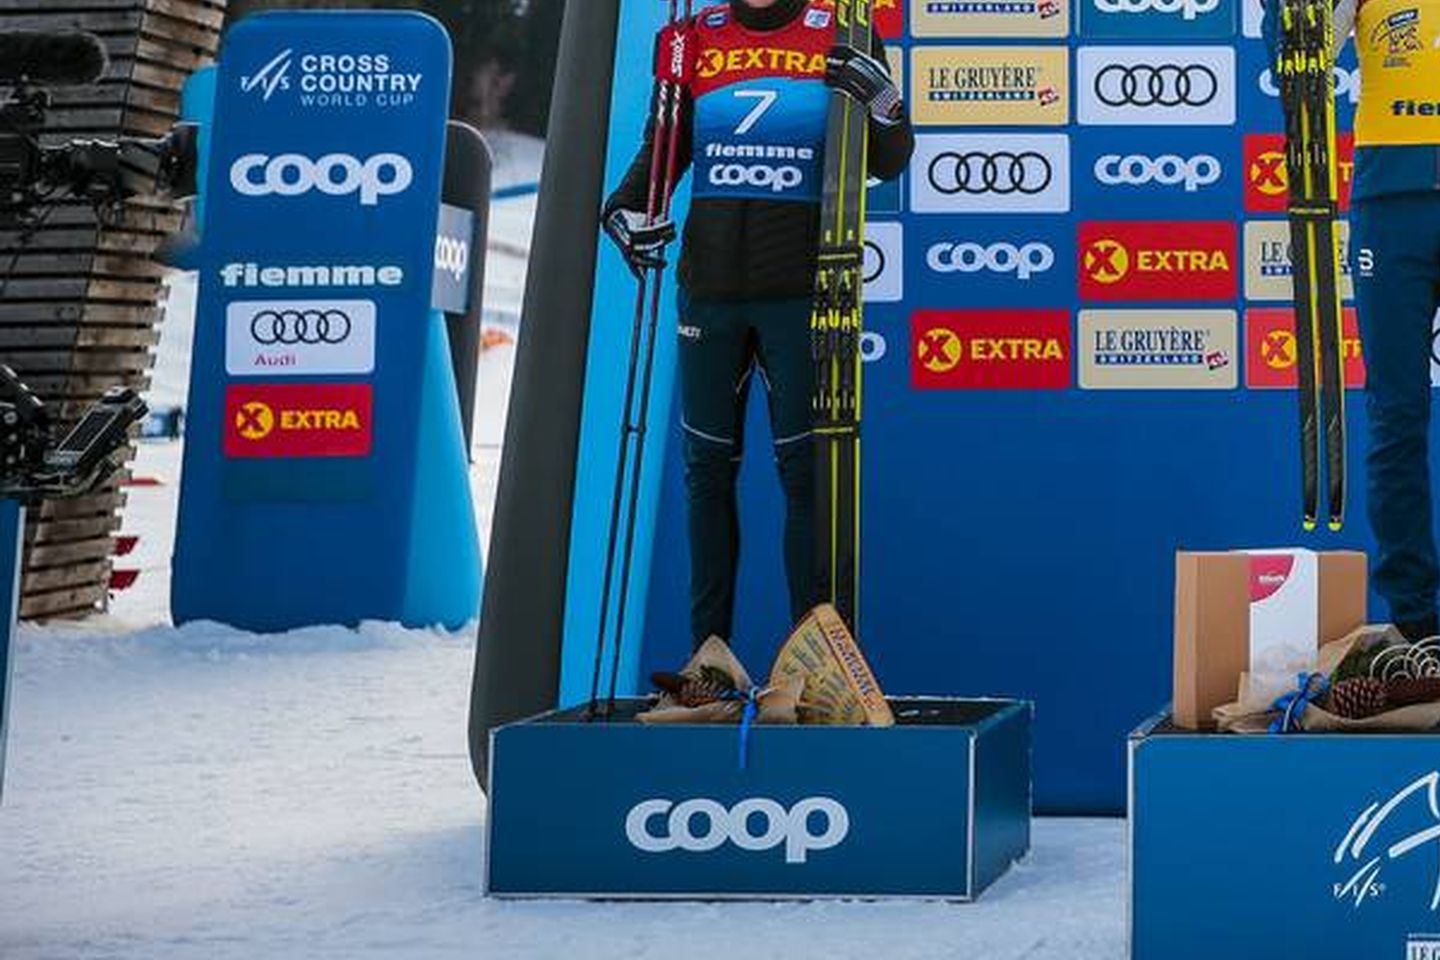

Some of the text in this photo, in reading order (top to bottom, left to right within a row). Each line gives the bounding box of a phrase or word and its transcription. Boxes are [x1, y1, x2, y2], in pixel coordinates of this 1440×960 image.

[301, 54, 390, 72] CROSS
[726, 48, 827, 74] EXTRA
[301, 73, 422, 93] COUNTRY
[928, 63, 1036, 88] LE GRUYÈRE
[301, 93, 414, 107] WORLD CUP
[733, 90, 778, 135] 7
[705, 143, 814, 160] fiemme
[229, 153, 413, 206] coop
[709, 164, 803, 192] coop
[1093, 155, 1221, 192] coop
[926, 241, 1054, 280] coop
[1137, 251, 1229, 272] EXTRA
[220, 263, 403, 286] fiemme
[970, 339, 1062, 360] EXTRA
[1095, 326, 1205, 352] LE GRUYÈRE
[254, 353, 297, 367] Audi
[280, 410, 360, 429] EXTRA
[625, 796, 850, 864] coop
